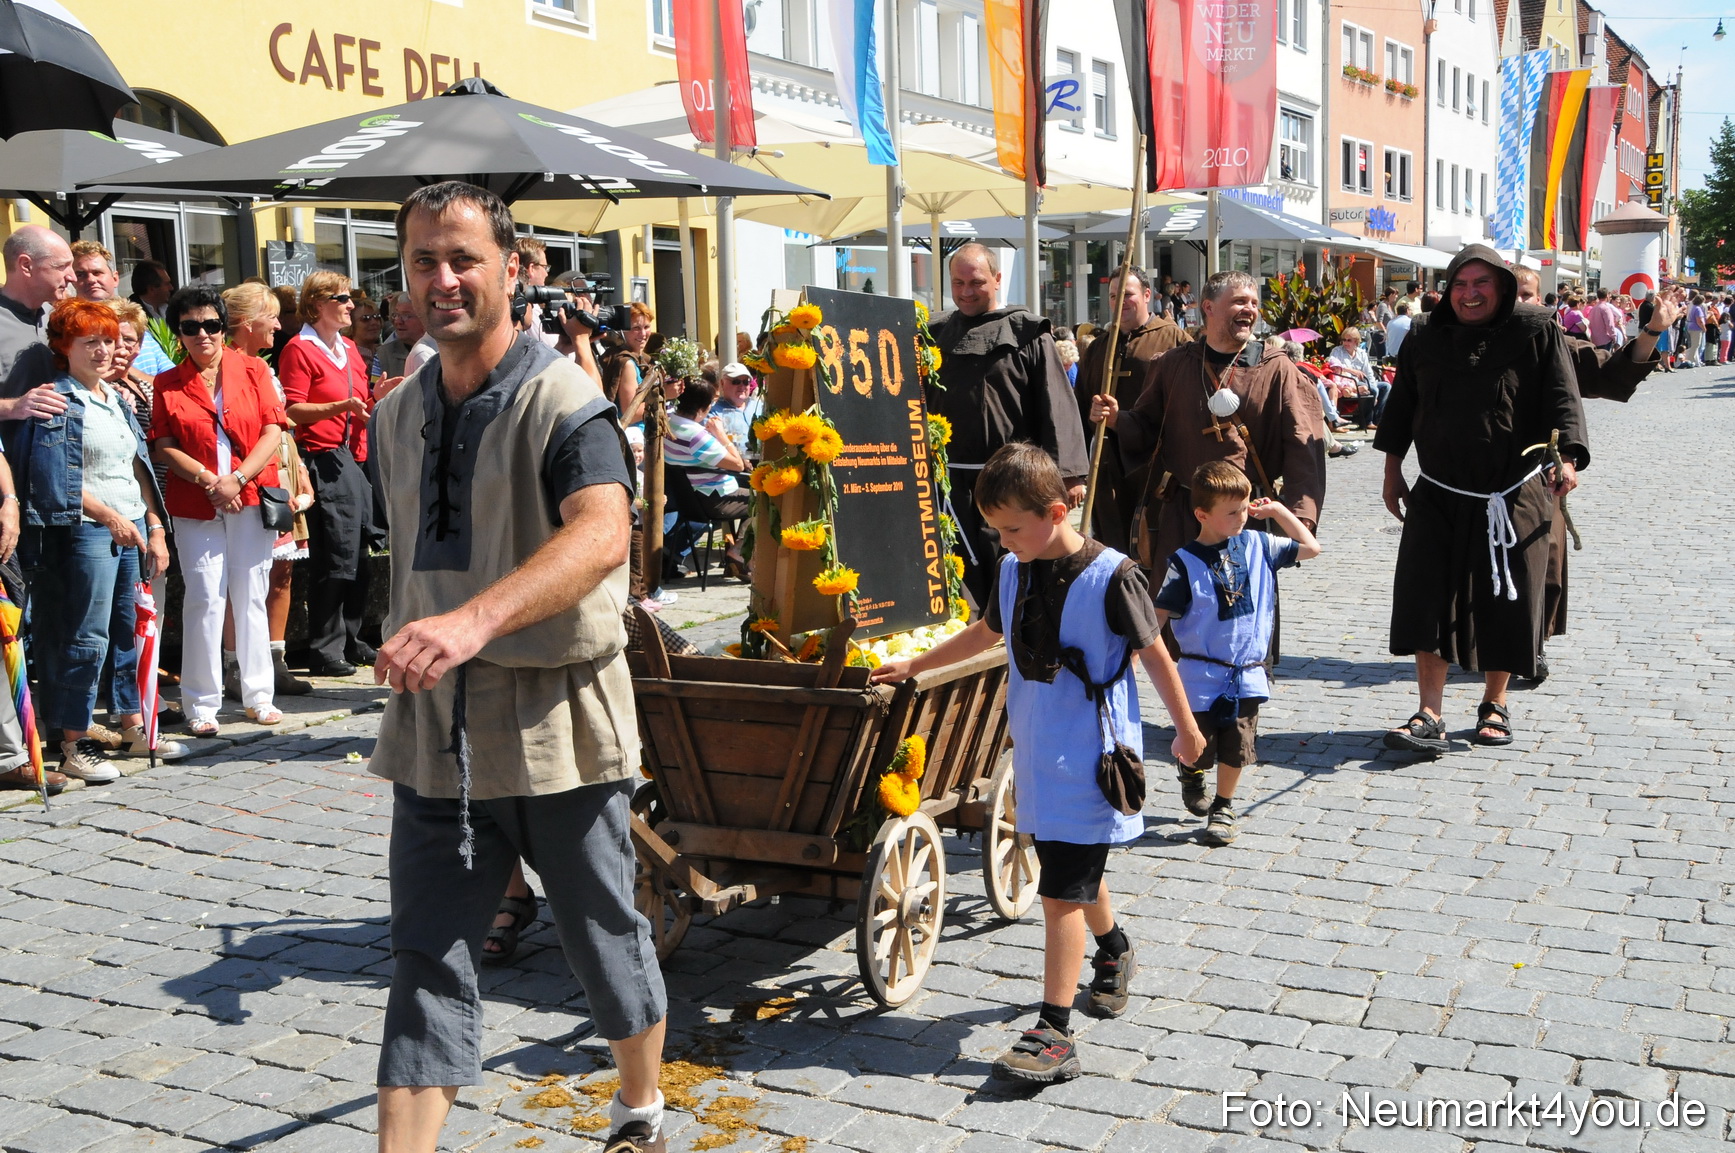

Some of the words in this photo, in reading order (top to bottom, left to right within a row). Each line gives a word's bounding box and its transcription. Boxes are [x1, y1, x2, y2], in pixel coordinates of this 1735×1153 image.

[1203, 21, 1256, 45] NEU
[269, 22, 385, 98] CAFE
[1201, 146, 1249, 169] 2010
[819, 324, 904, 398] 850
[842, 443, 880, 454] onderausstellung
[907, 399, 945, 615] STADTMUSEUM
